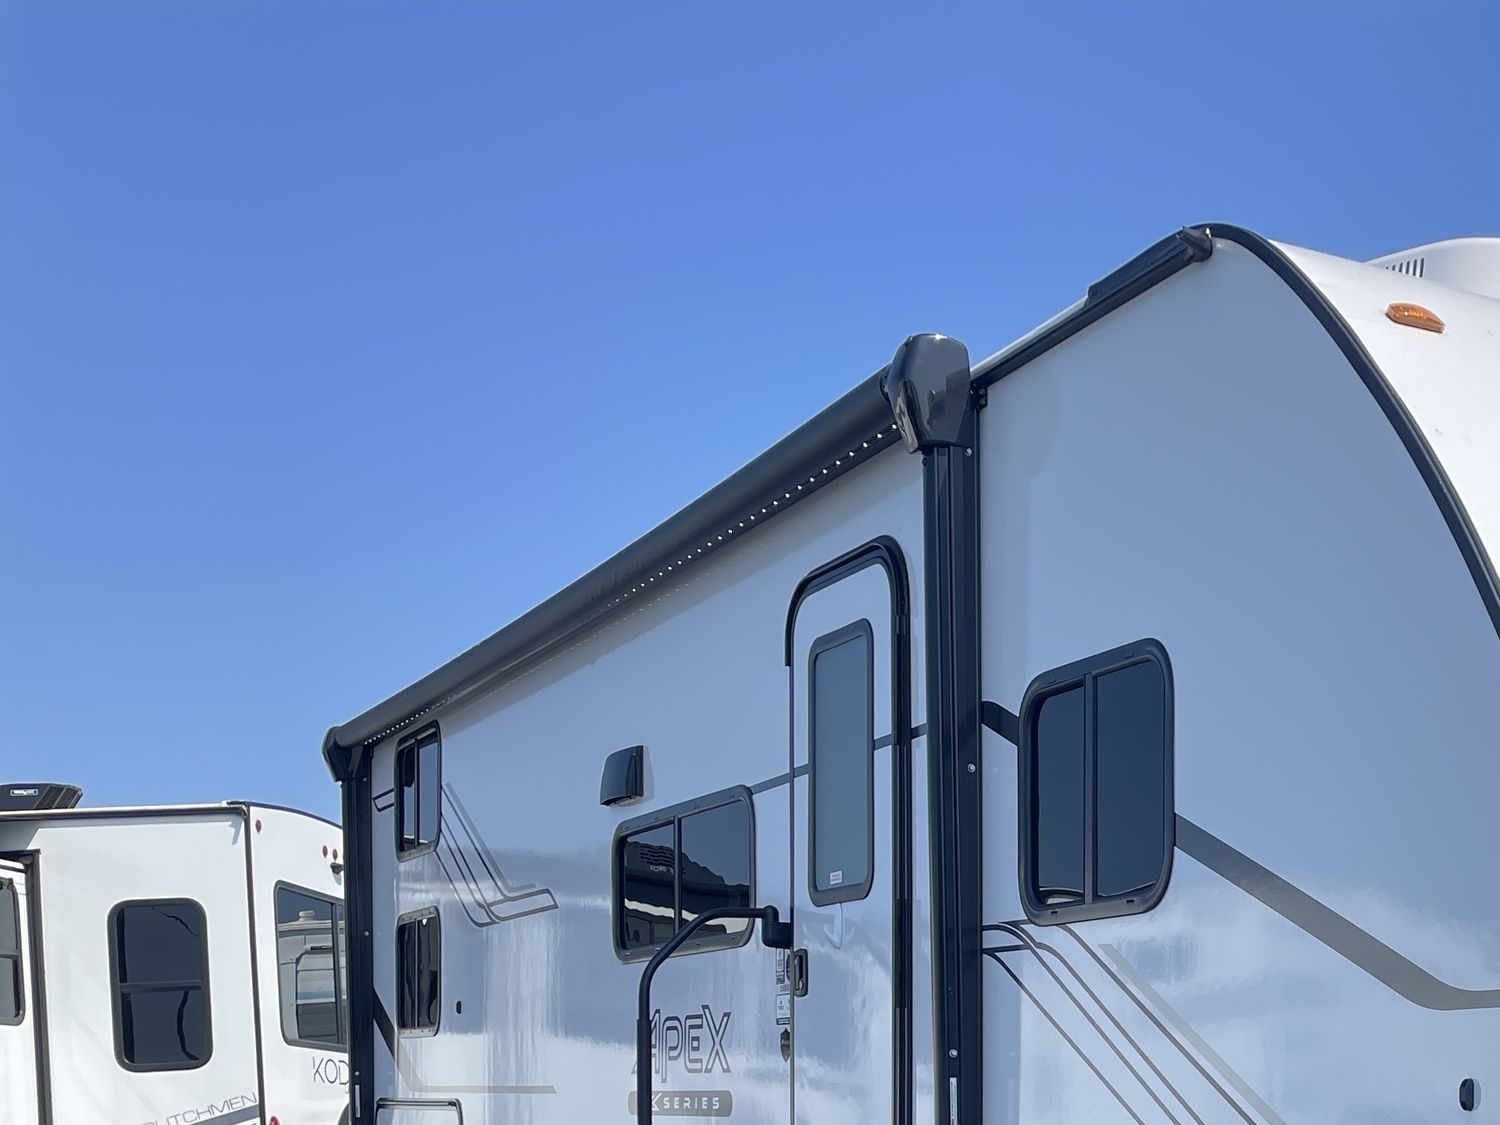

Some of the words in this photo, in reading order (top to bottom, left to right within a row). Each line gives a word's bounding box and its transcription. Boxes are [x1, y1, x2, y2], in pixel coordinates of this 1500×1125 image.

[631, 1004, 732, 1083] APEX
[312, 1056, 350, 1085] KOD
[663, 1096, 720, 1110] SERIES
